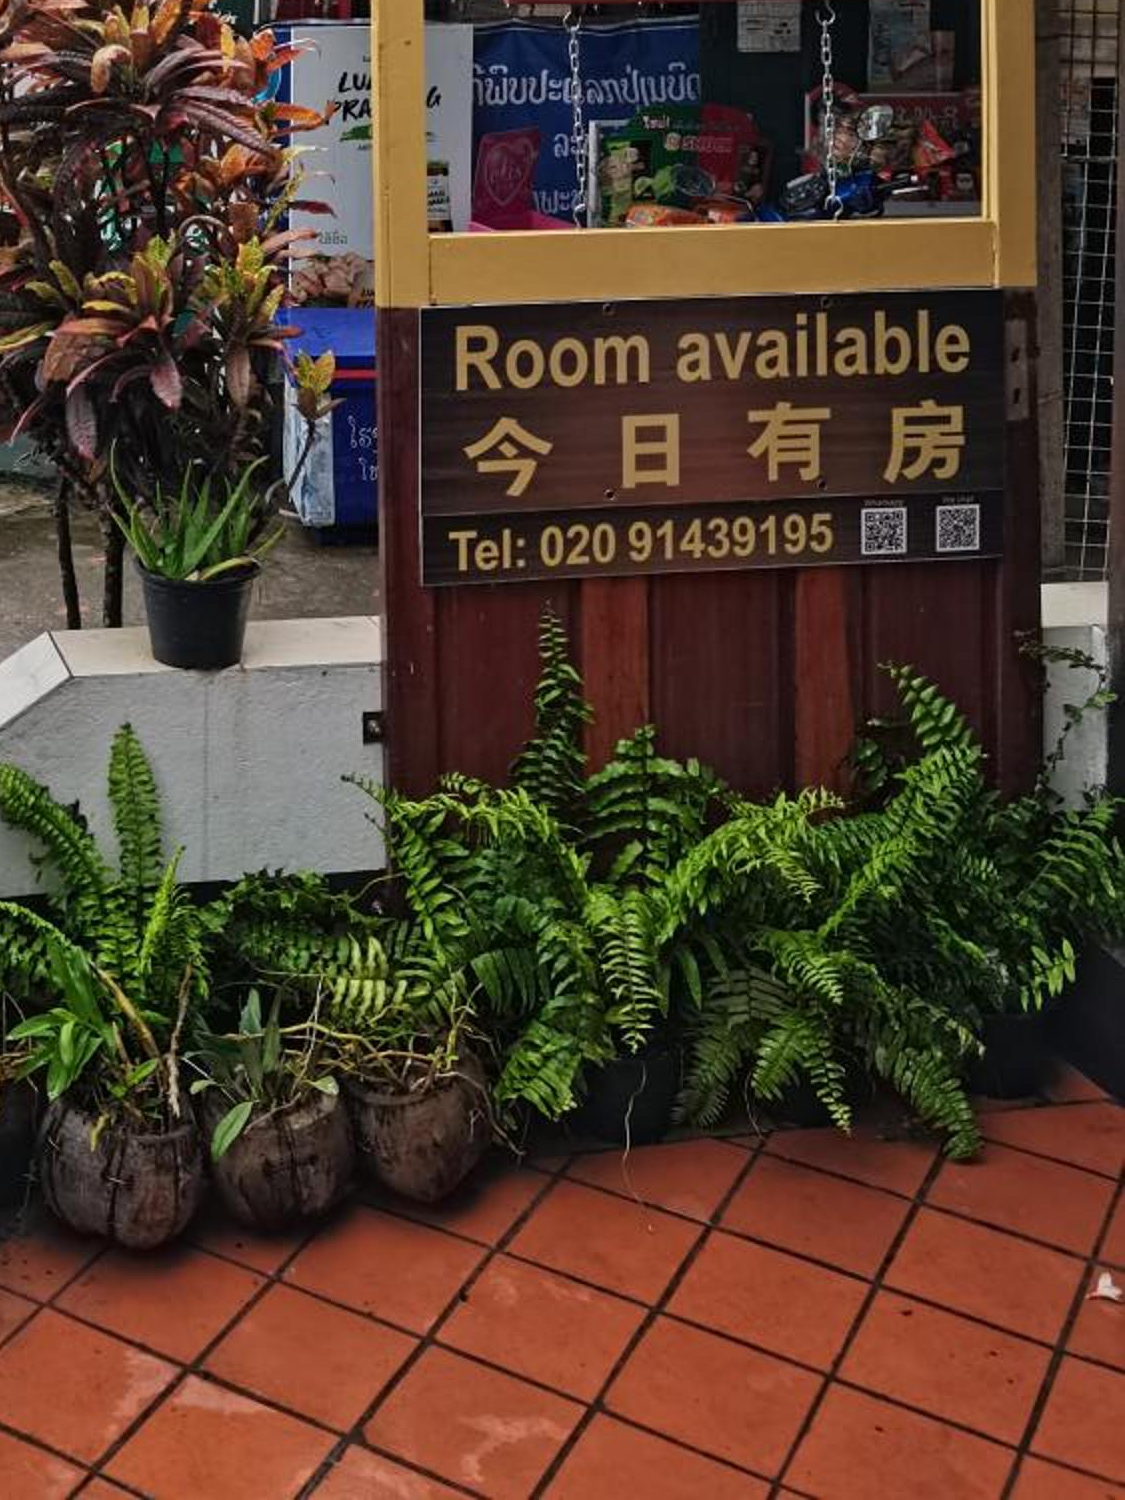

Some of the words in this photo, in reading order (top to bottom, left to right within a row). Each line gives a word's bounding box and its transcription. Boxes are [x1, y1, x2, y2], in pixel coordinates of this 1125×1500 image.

[456, 325, 650, 391] Room
[677, 309, 971, 382] available
[464, 400, 966, 496] 今日有房
[449, 528, 527, 571] Tel:
[540, 524, 616, 567] 020
[628, 513, 834, 561] 91439195
